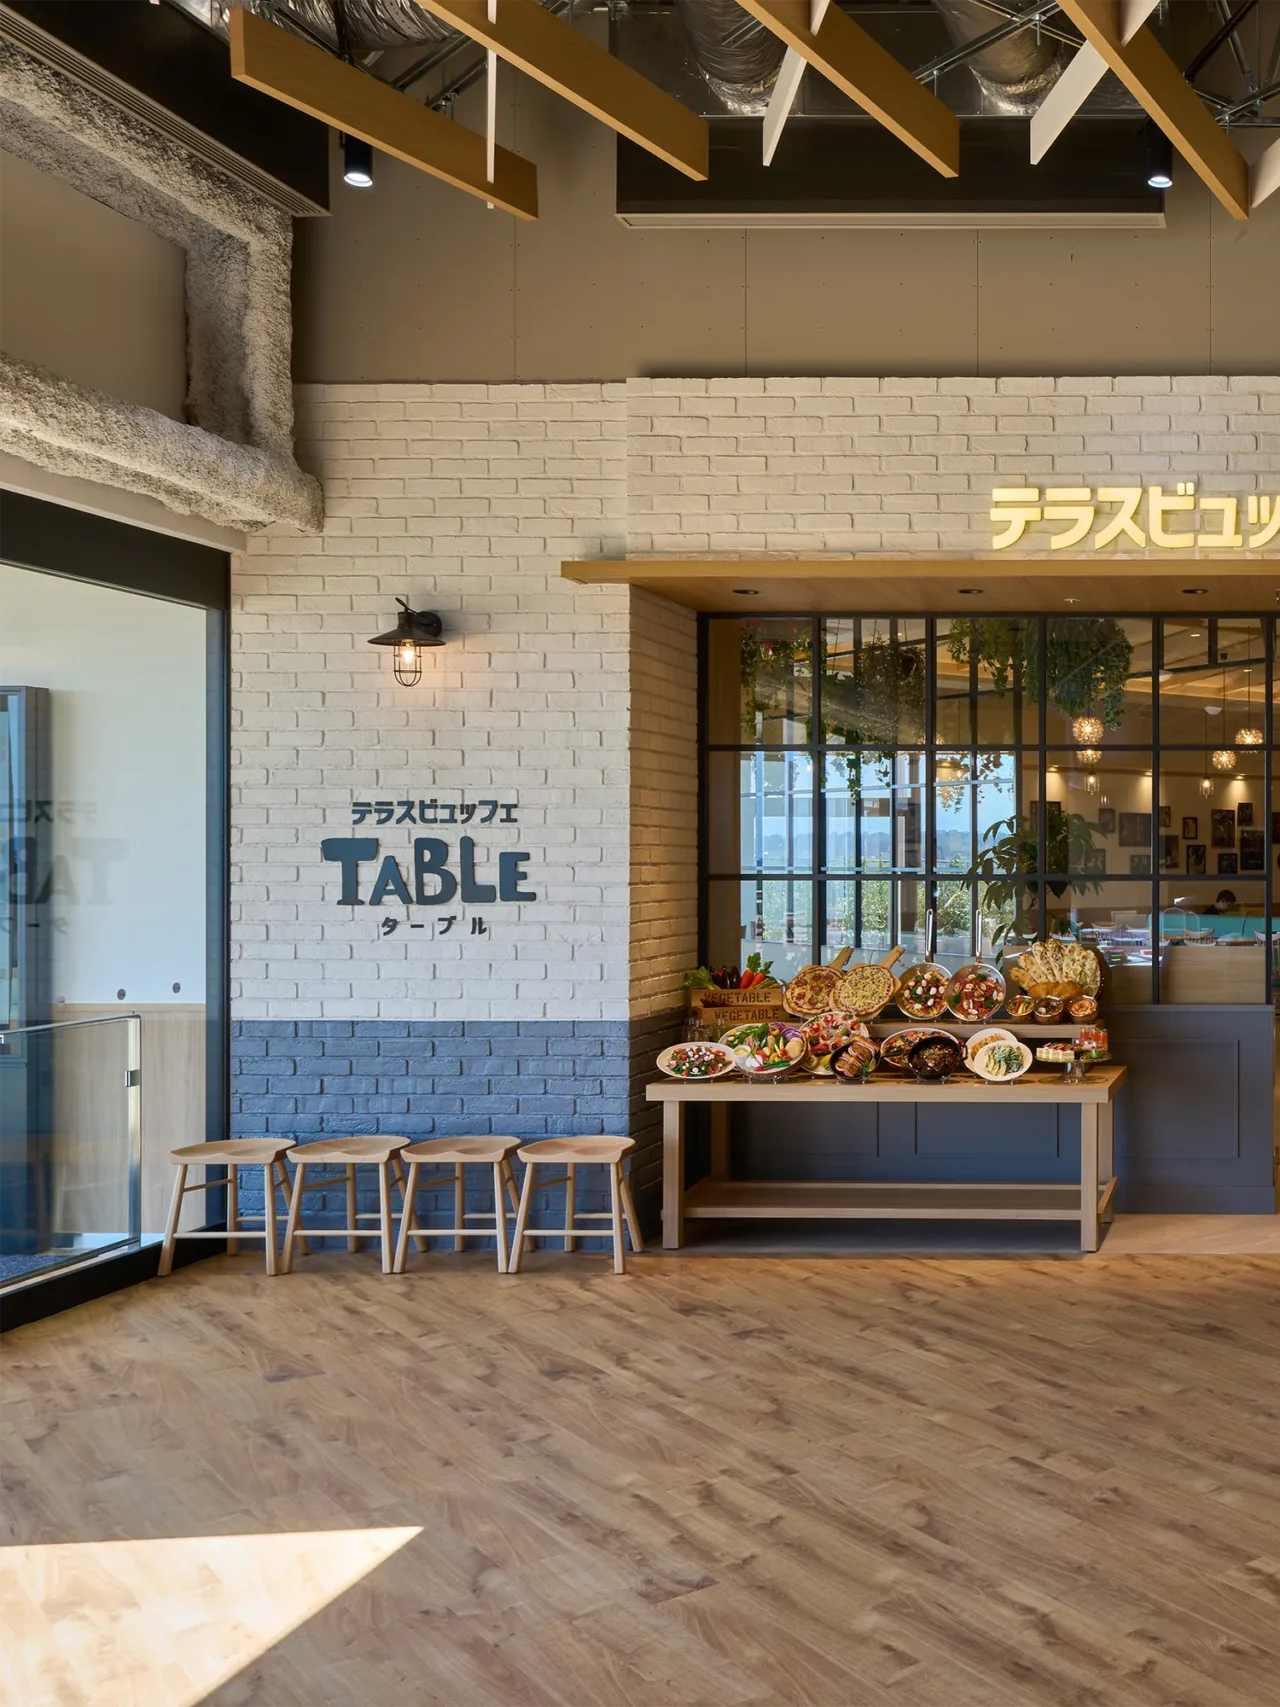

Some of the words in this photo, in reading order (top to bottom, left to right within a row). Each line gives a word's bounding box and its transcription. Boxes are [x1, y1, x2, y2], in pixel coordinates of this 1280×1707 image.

[351, 799, 518, 825] テラスビュッフェ
[320, 835, 537, 906] TABLE
[381, 916, 487, 935] ターブル
[704, 992, 771, 1003] VEGETABLE
[714, 1008, 779, 1021] VEGETABLE
